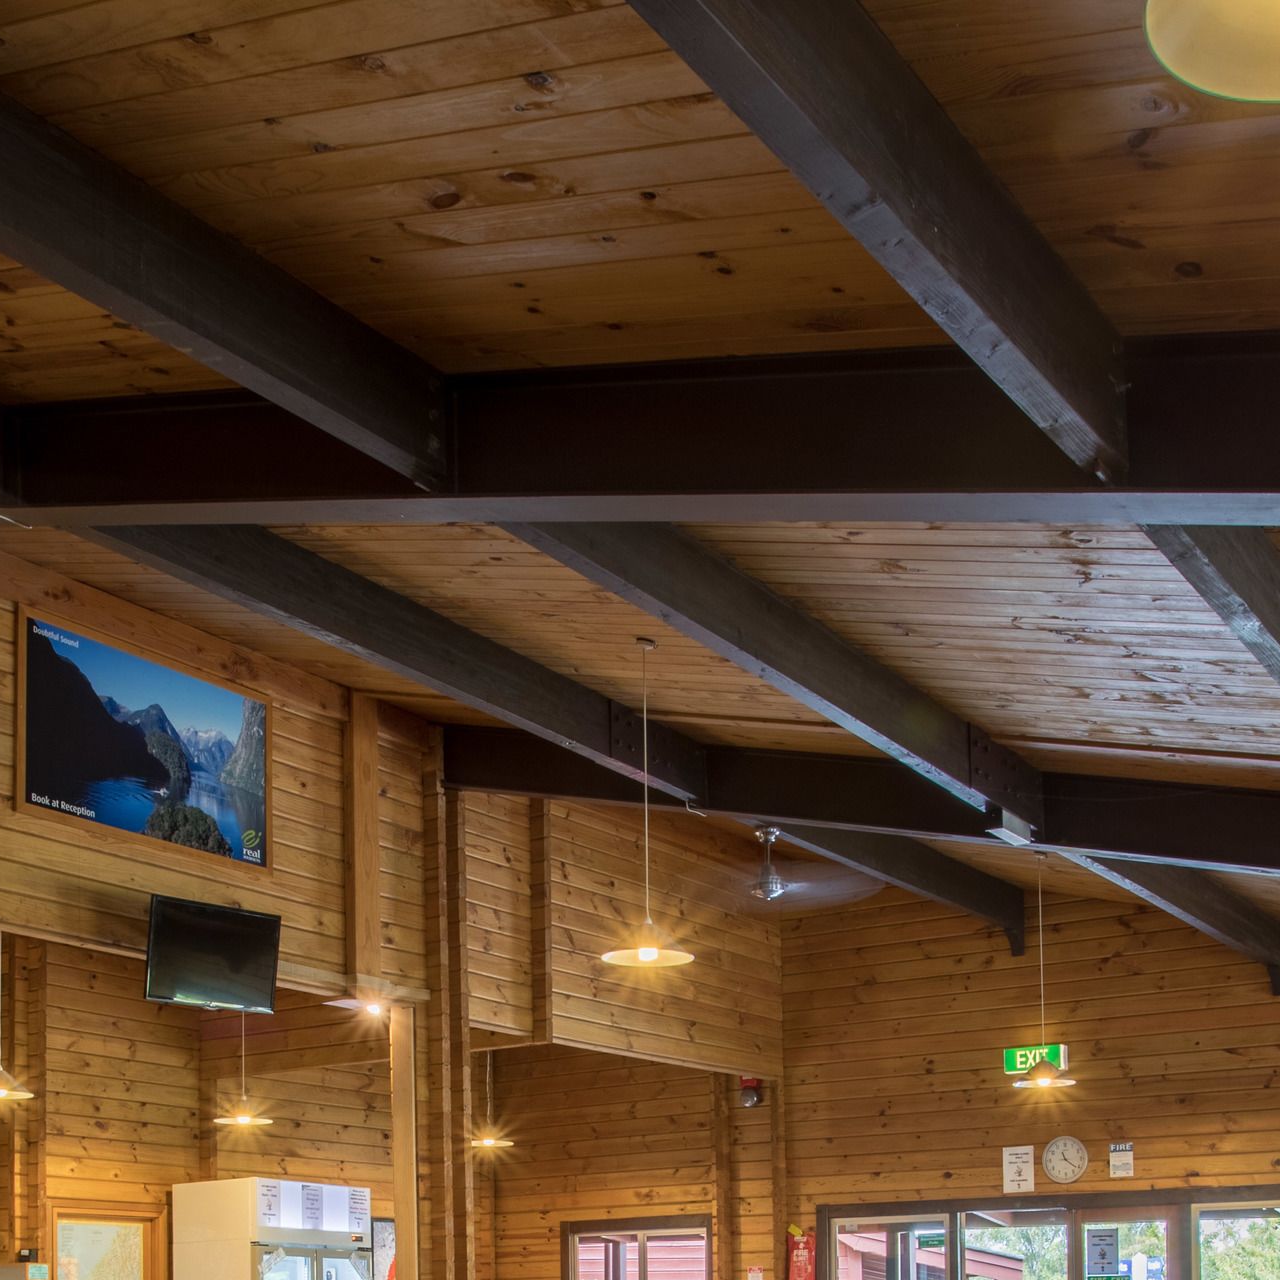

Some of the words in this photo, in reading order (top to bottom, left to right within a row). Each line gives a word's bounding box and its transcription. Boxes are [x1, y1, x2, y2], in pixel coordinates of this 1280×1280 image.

[33, 625, 60, 641] Doubtful
[60, 635, 79, 648] Sound
[31, 792, 51, 806] Book
[52, 800, 60, 809] at
[60, 800, 96, 818] Reception
[243, 847, 261, 859] real
[1110, 1143, 1133, 1152] FIRE
